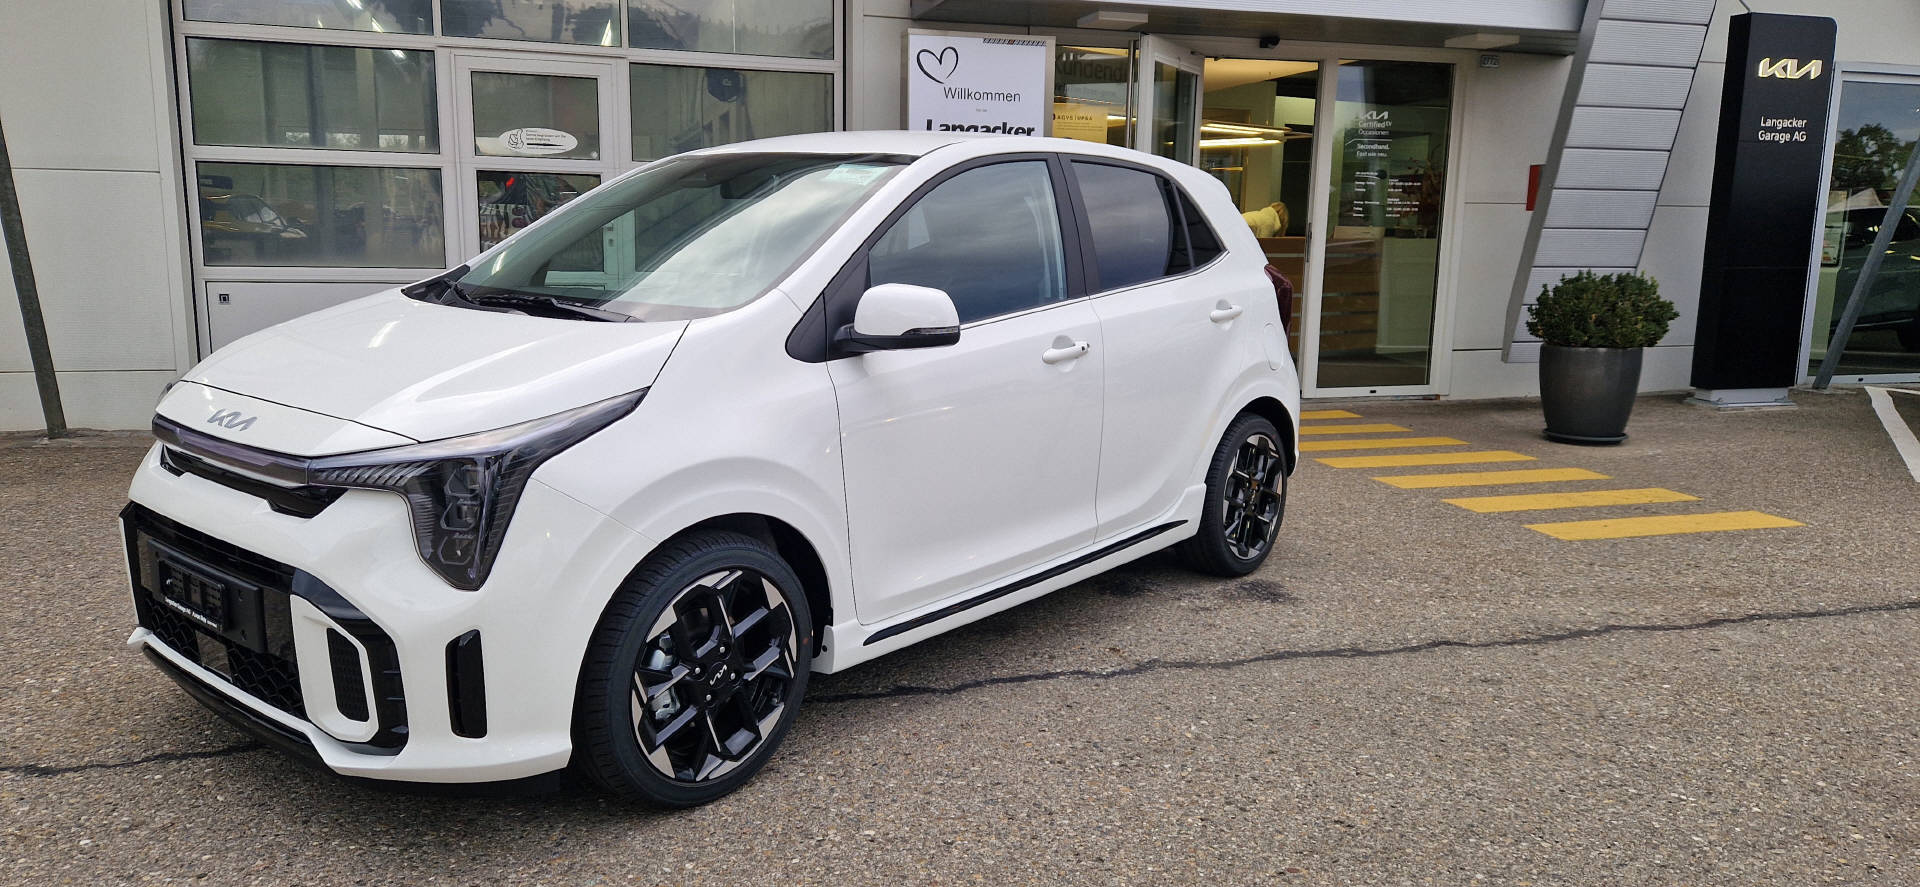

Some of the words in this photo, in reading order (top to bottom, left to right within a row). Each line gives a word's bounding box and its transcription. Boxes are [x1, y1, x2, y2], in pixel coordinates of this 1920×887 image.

[1758, 57, 1823, 80] KIA
[943, 86, 1021, 102] Willkommen
[1359, 120, 1385, 128] Certified
[1760, 116, 1807, 130] Langacker
[1758, 130, 1790, 143] Garage
[1792, 131, 1807, 142] AG
[207, 408, 258, 432] KIA
